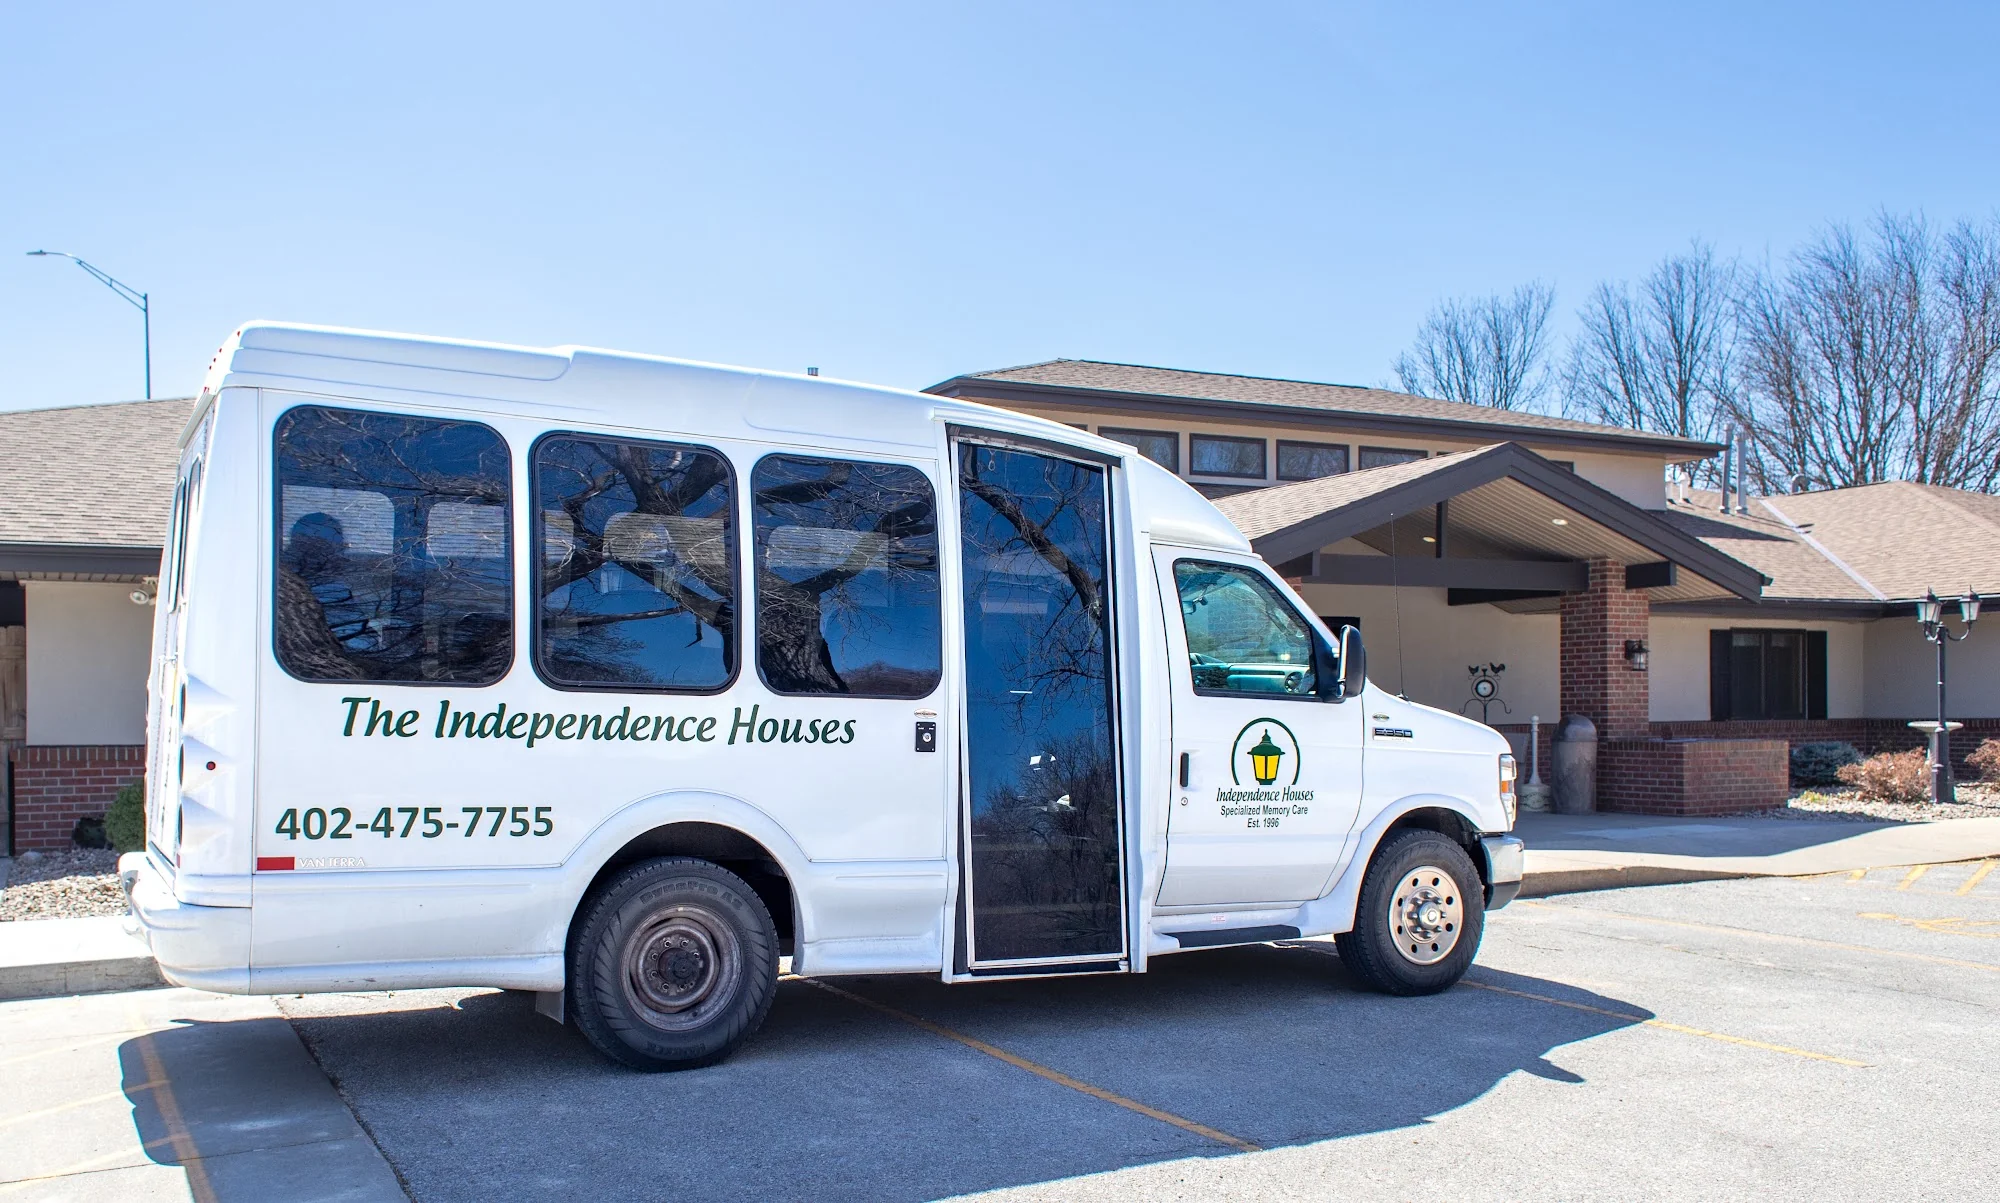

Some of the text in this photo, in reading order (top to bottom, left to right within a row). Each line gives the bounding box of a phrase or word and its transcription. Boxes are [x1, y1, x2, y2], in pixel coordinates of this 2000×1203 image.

[341, 697, 857, 749] The Independence Houses
[1216, 786, 1314, 804] Independence Houses
[1220, 804, 1309, 818] Specialized Memory Care
[276, 806, 554, 841] 402-475-7755
[1247, 817, 1280, 828] Est. 1996
[299, 857, 365, 868] VAN TERRA
